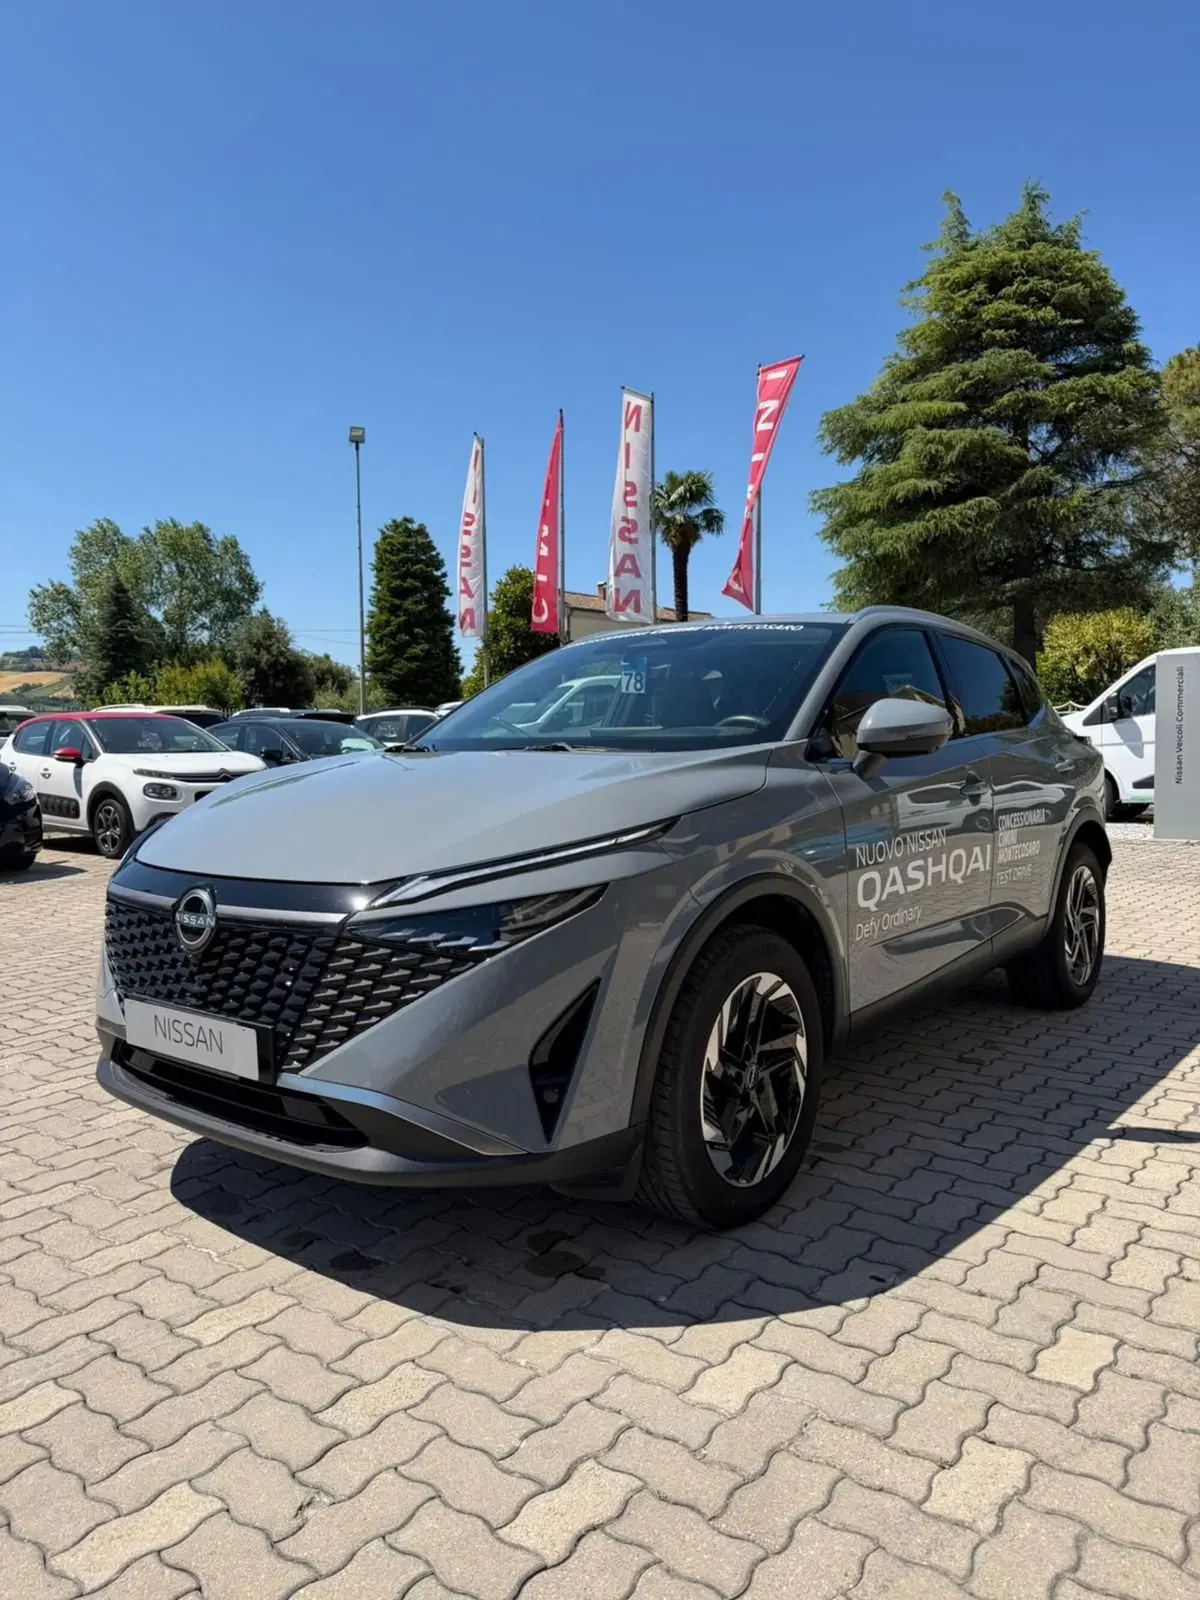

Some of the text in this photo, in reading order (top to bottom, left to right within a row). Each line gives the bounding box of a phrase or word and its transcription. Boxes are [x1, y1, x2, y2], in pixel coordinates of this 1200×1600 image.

[623, 671, 644, 692] 78
[1176, 666, 1184, 722] Commerciali
[1175, 754, 1183, 785] Nissan
[998, 808, 1046, 832] CONCESSIONARIA
[855, 828, 947, 868] NUOVO NISSAN
[857, 844, 991, 911] QASHQAI
[996, 869, 1012, 885] TEST
[177, 912, 216, 926] NISSAN
[856, 905, 923, 941] Defy Ordinary
[153, 1014, 224, 1055] NISSAN
